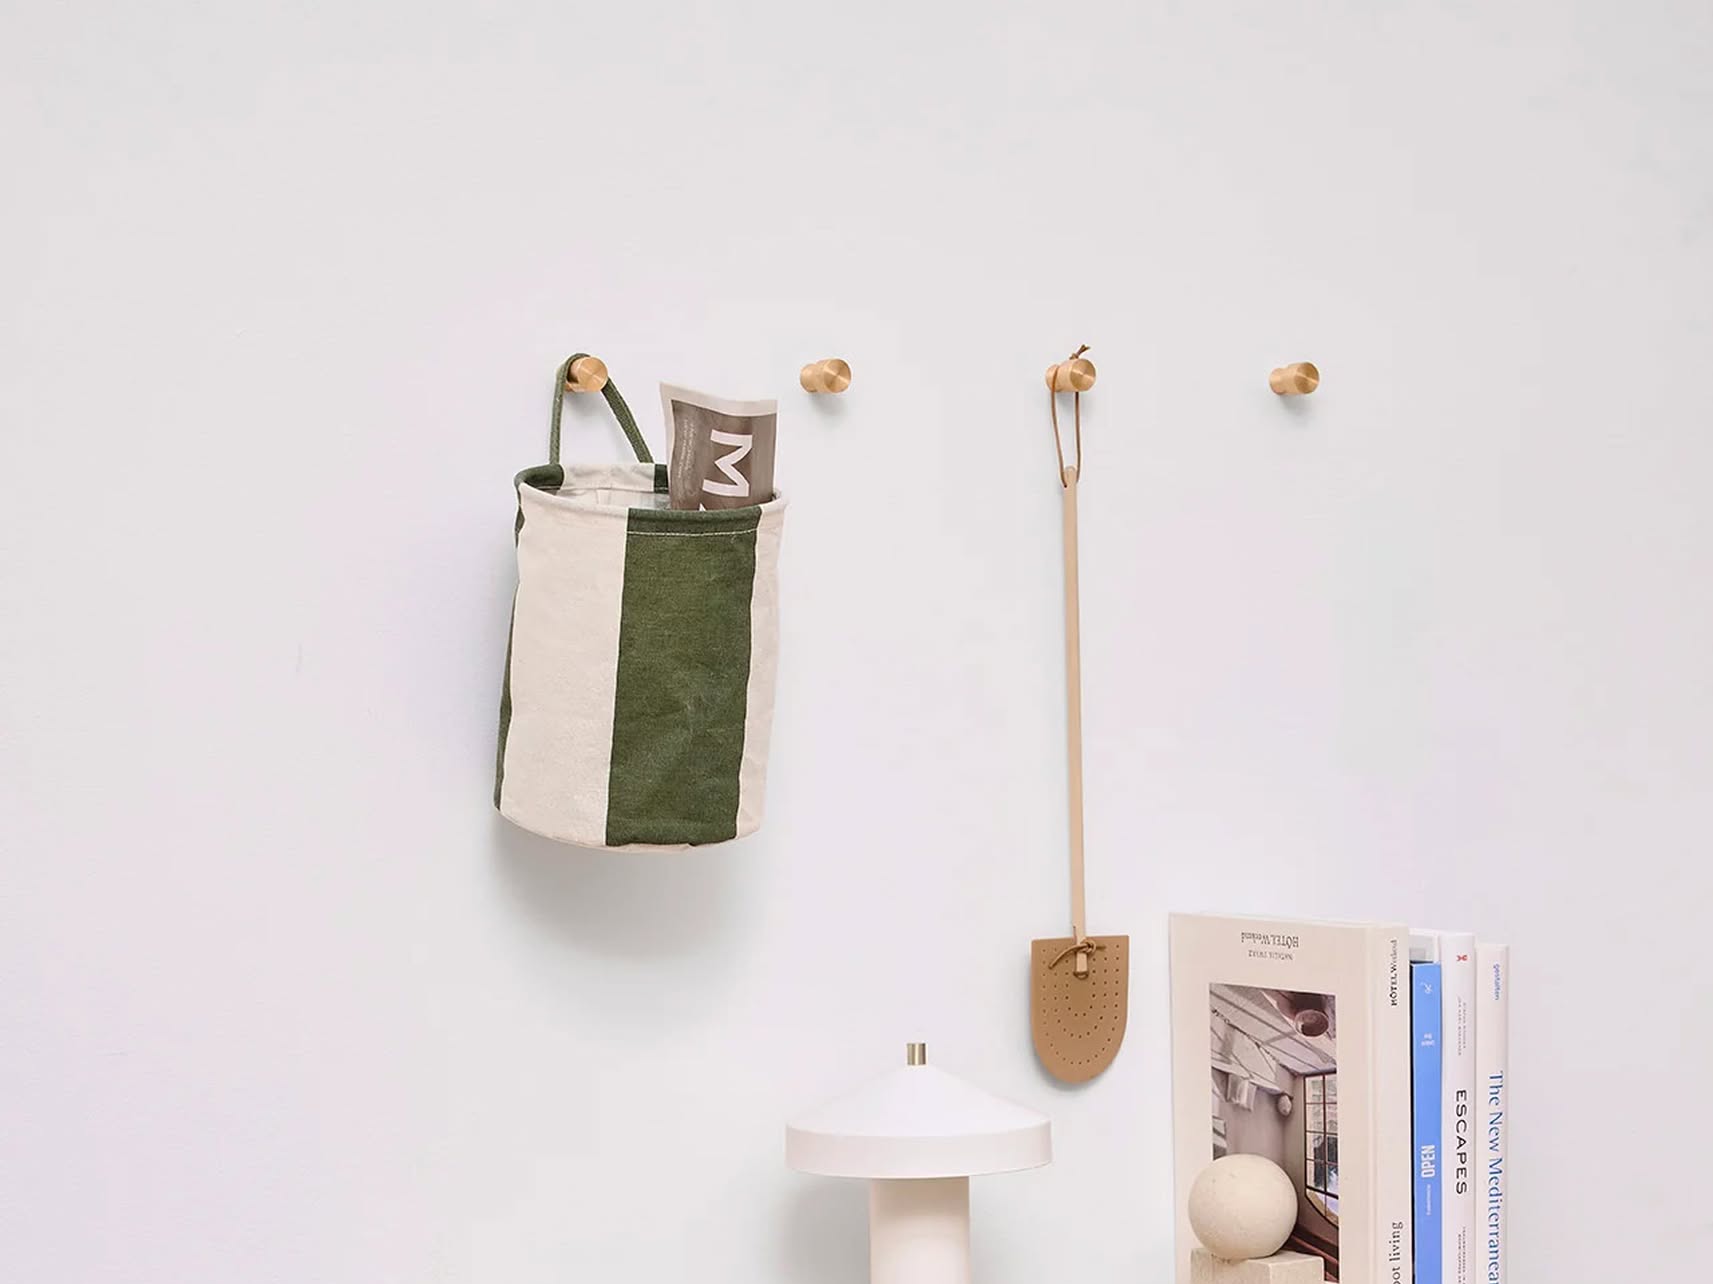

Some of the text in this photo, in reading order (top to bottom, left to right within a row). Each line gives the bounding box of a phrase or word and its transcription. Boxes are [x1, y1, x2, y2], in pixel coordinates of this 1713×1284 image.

[699, 428, 753, 512] M
[1488, 1070, 1503, 1106] The
[1455, 1089, 1467, 1194] ESCAPES
[1488, 1111, 1503, 1152] New
[1421, 1144, 1435, 1178] OPEN
[1388, 1221, 1403, 1261] living
